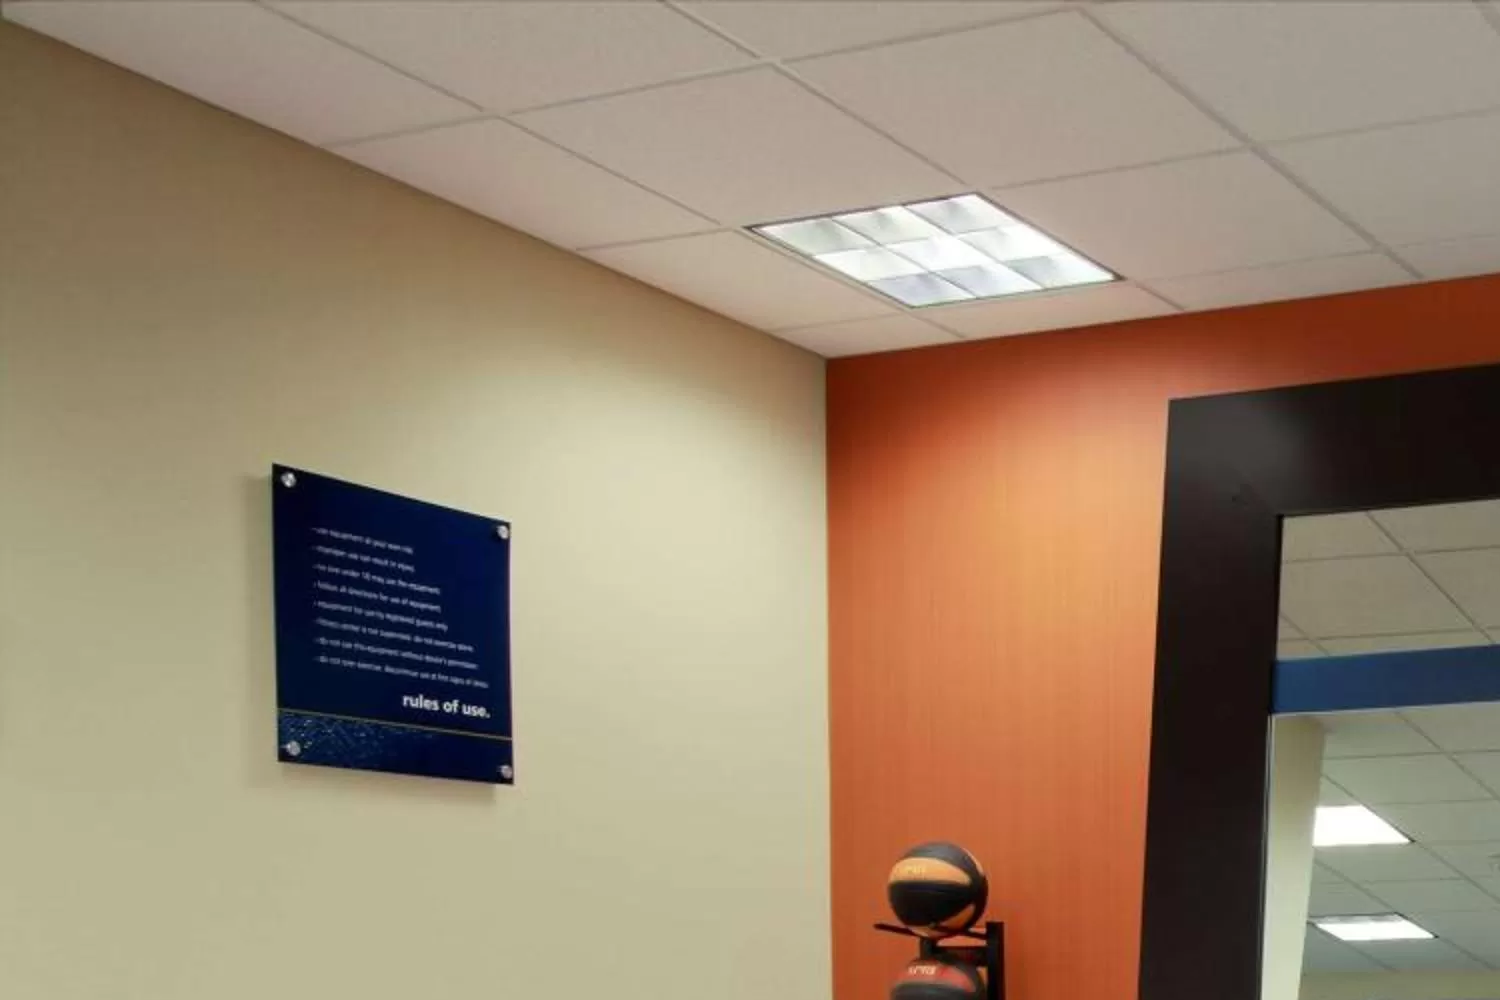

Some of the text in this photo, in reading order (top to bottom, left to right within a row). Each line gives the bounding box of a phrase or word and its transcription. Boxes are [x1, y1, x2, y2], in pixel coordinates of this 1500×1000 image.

[403, 694, 491, 718] rules of use.
